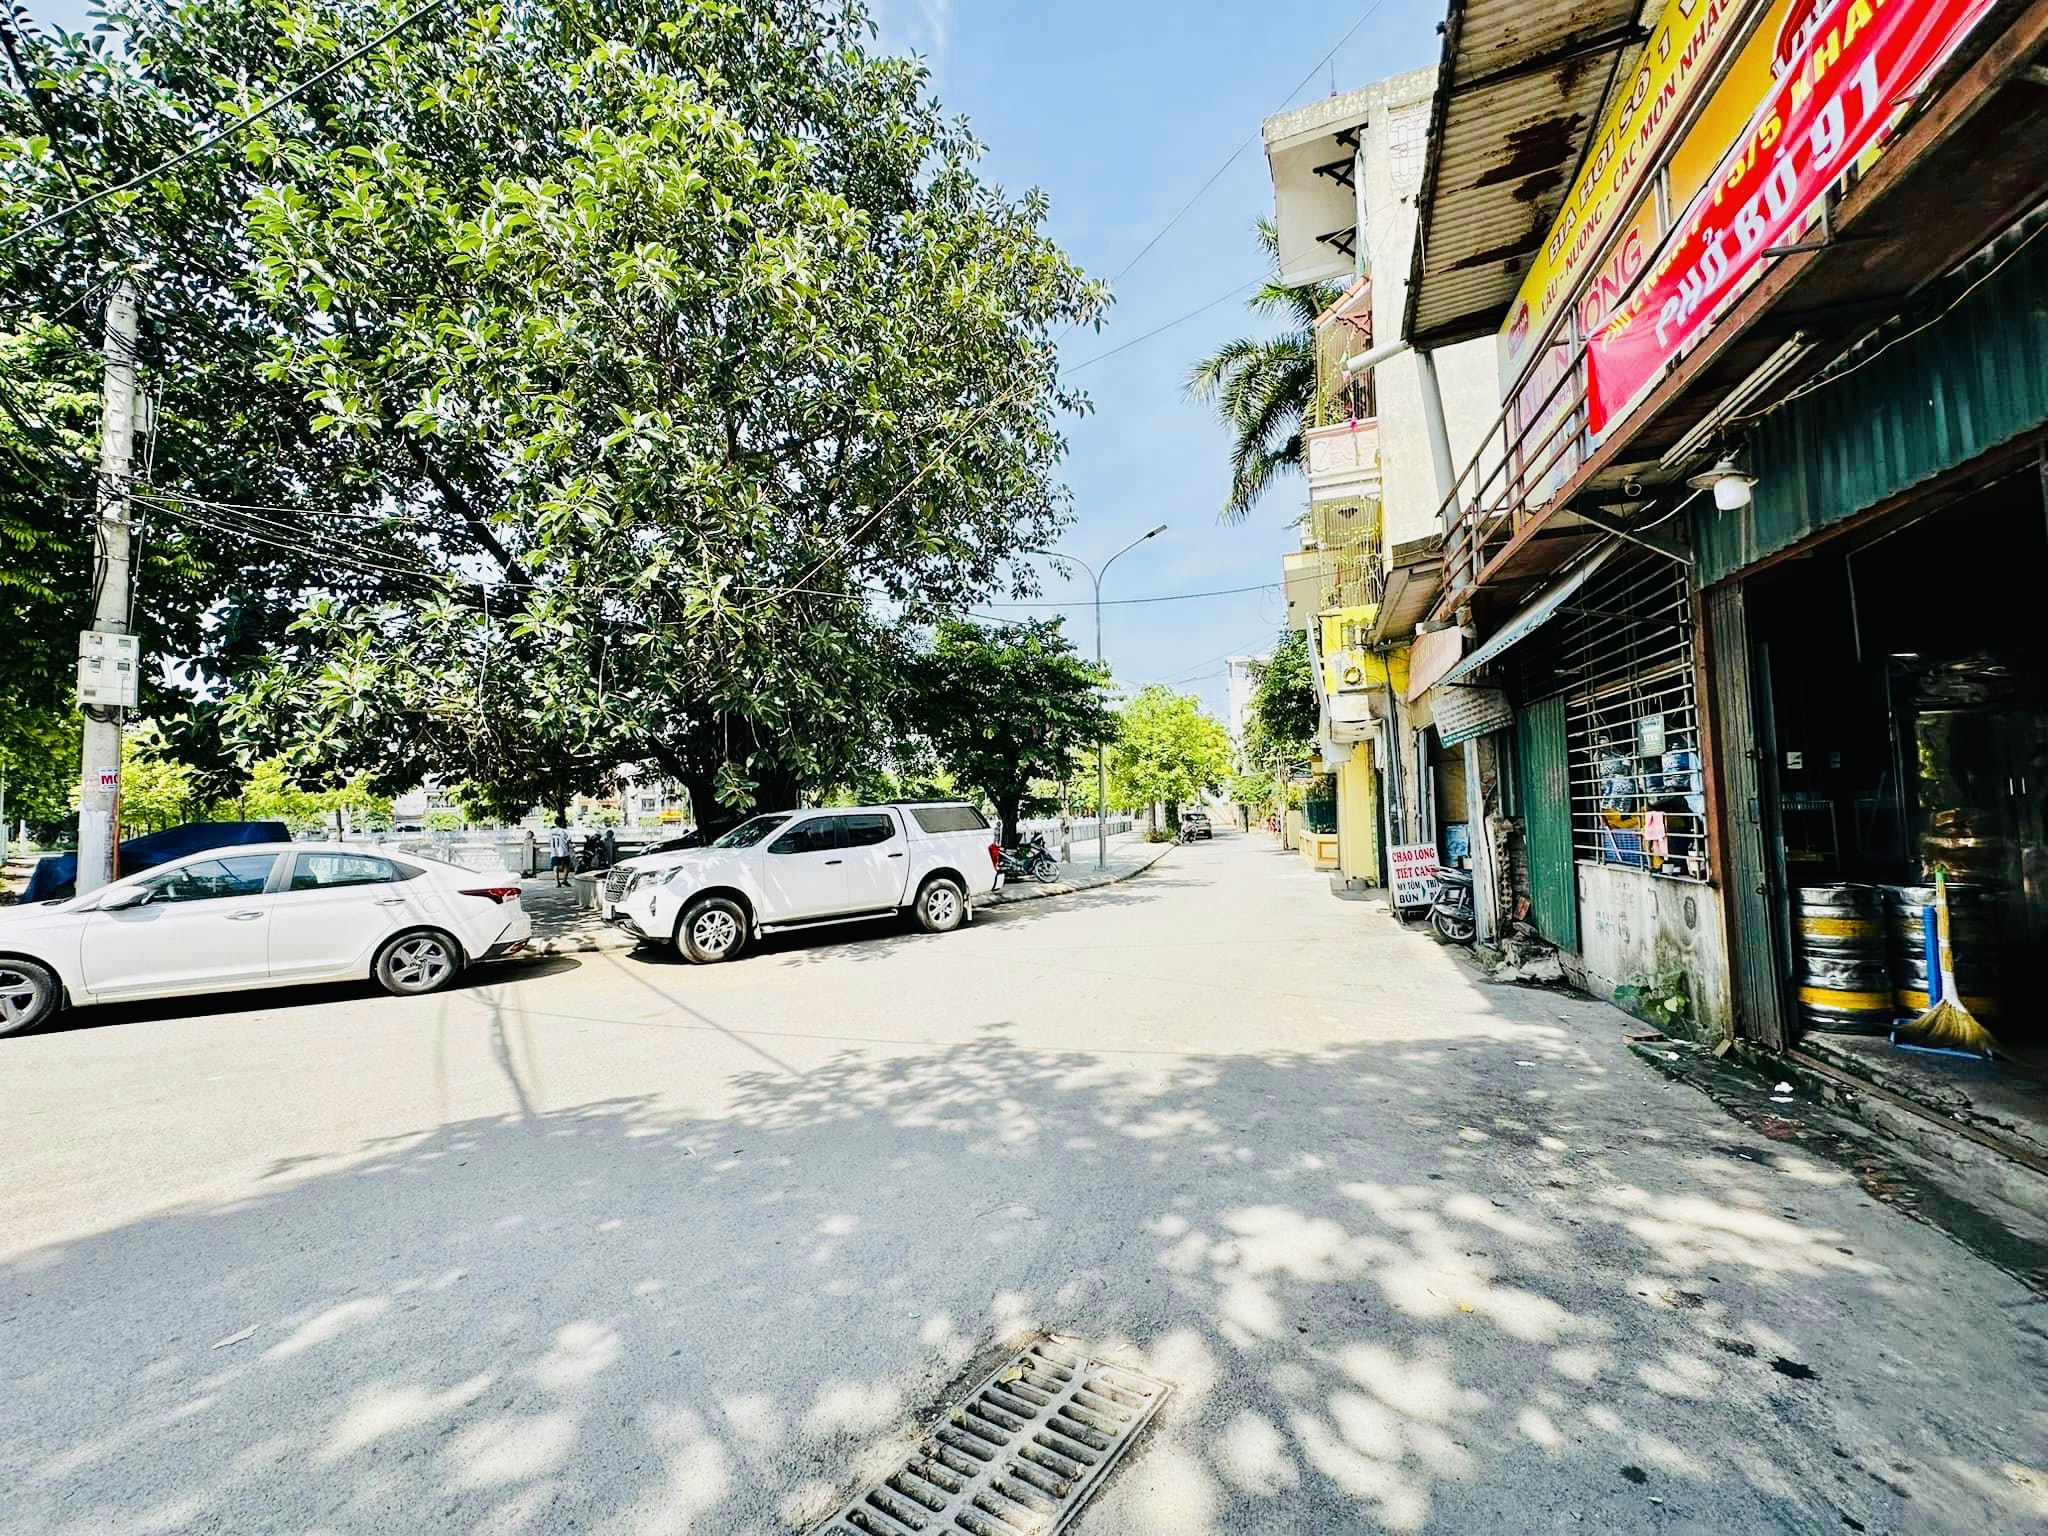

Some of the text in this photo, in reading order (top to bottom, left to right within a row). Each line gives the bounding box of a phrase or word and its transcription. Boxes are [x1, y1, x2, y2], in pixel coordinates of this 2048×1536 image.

[1549, 207, 1577, 267] BIA
[1658, 26, 1671, 64] 1
[1655, 225, 1729, 349] PHỞ
[1734, 144, 1798, 261] BÒ
[1808, 49, 1880, 172] 91
[1399, 891, 1419, 904] BÚN
